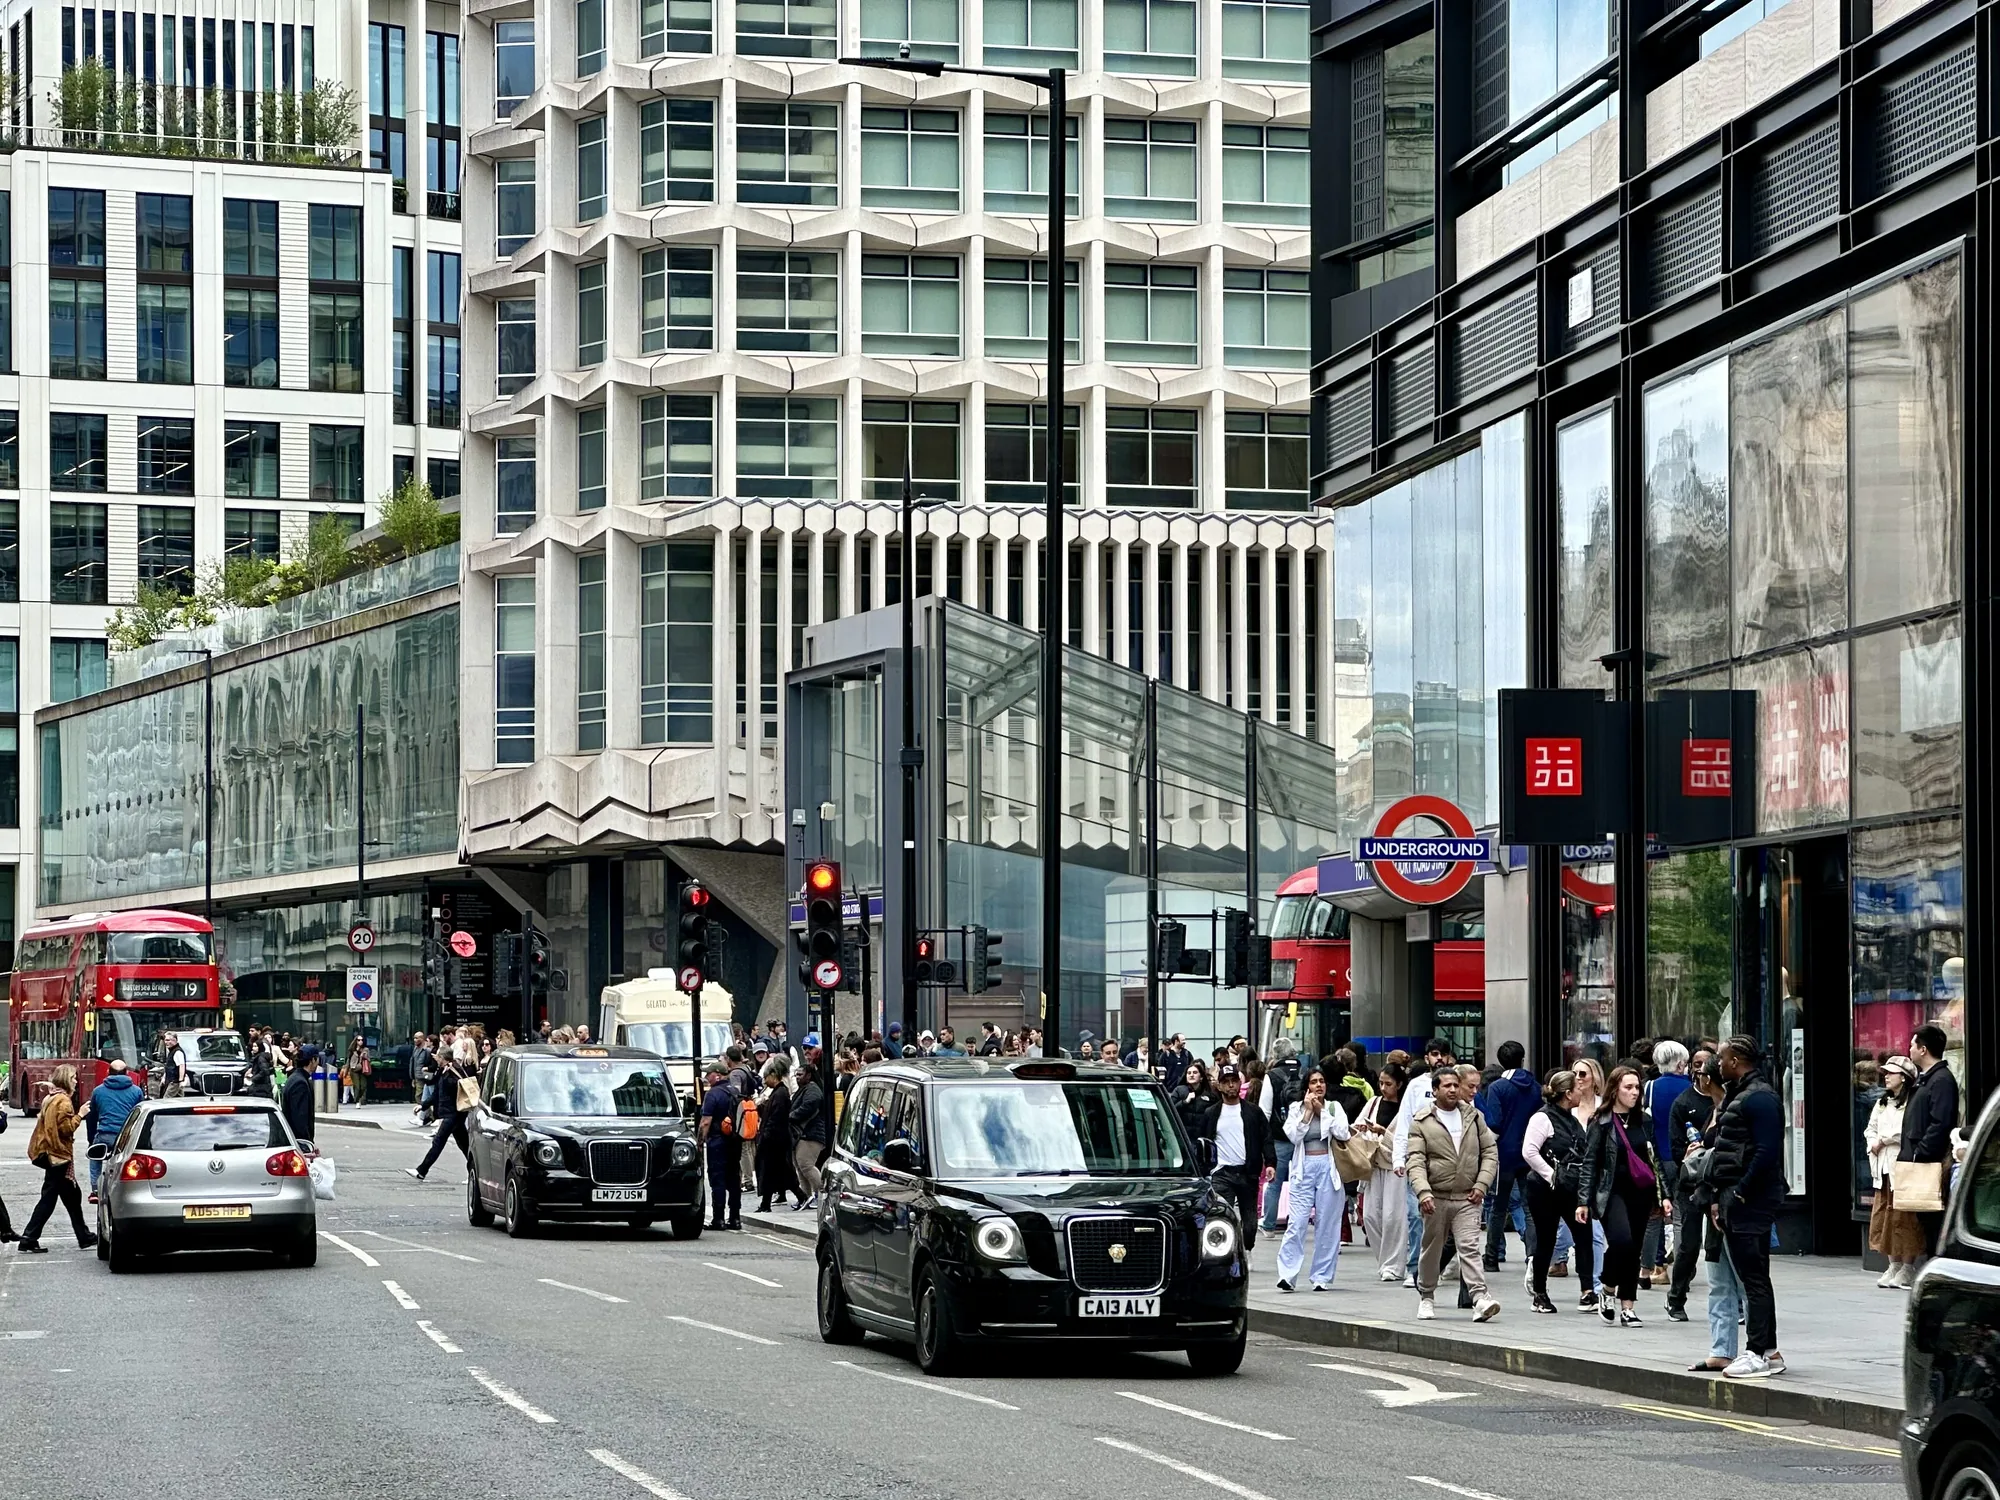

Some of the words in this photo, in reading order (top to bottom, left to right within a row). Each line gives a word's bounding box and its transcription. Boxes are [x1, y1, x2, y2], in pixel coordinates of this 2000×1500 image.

[1365, 842, 1484, 856] UNDERGROUND
[353, 933, 371, 944] 20
[122, 983, 151, 991] Battersea
[151, 982, 170, 993] Bridge
[184, 982, 198, 996] 19
[645, 1000, 667, 1008] GELATO
[596, 1190, 622, 1200] LM72
[1085, 1299, 1120, 1315] CA13
[1124, 1299, 1155, 1315] ALY
